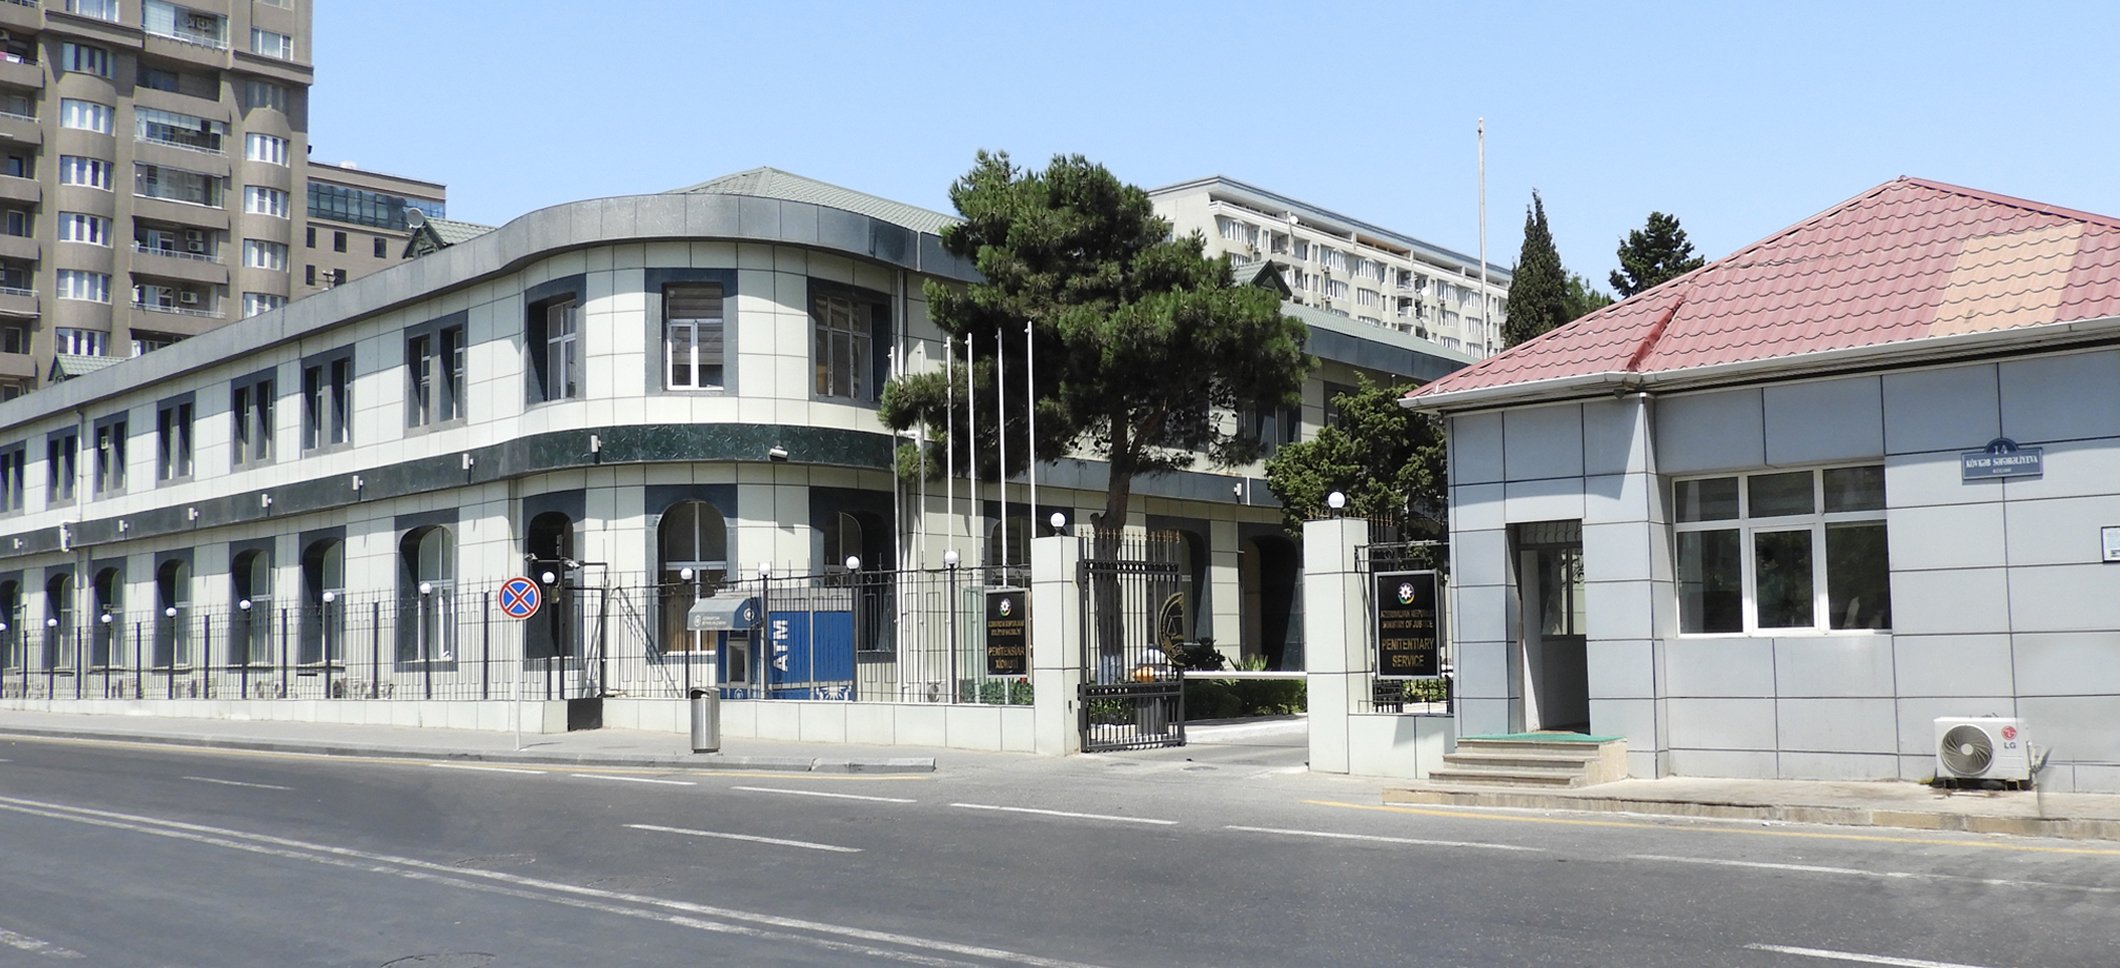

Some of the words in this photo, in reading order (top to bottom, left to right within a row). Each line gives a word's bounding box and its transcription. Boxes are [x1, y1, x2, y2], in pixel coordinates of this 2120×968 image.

[773, 619, 788, 672] ATM
[1381, 638, 1435, 651] PENITENTIARY
[1392, 655, 1425, 668] SERVICE
